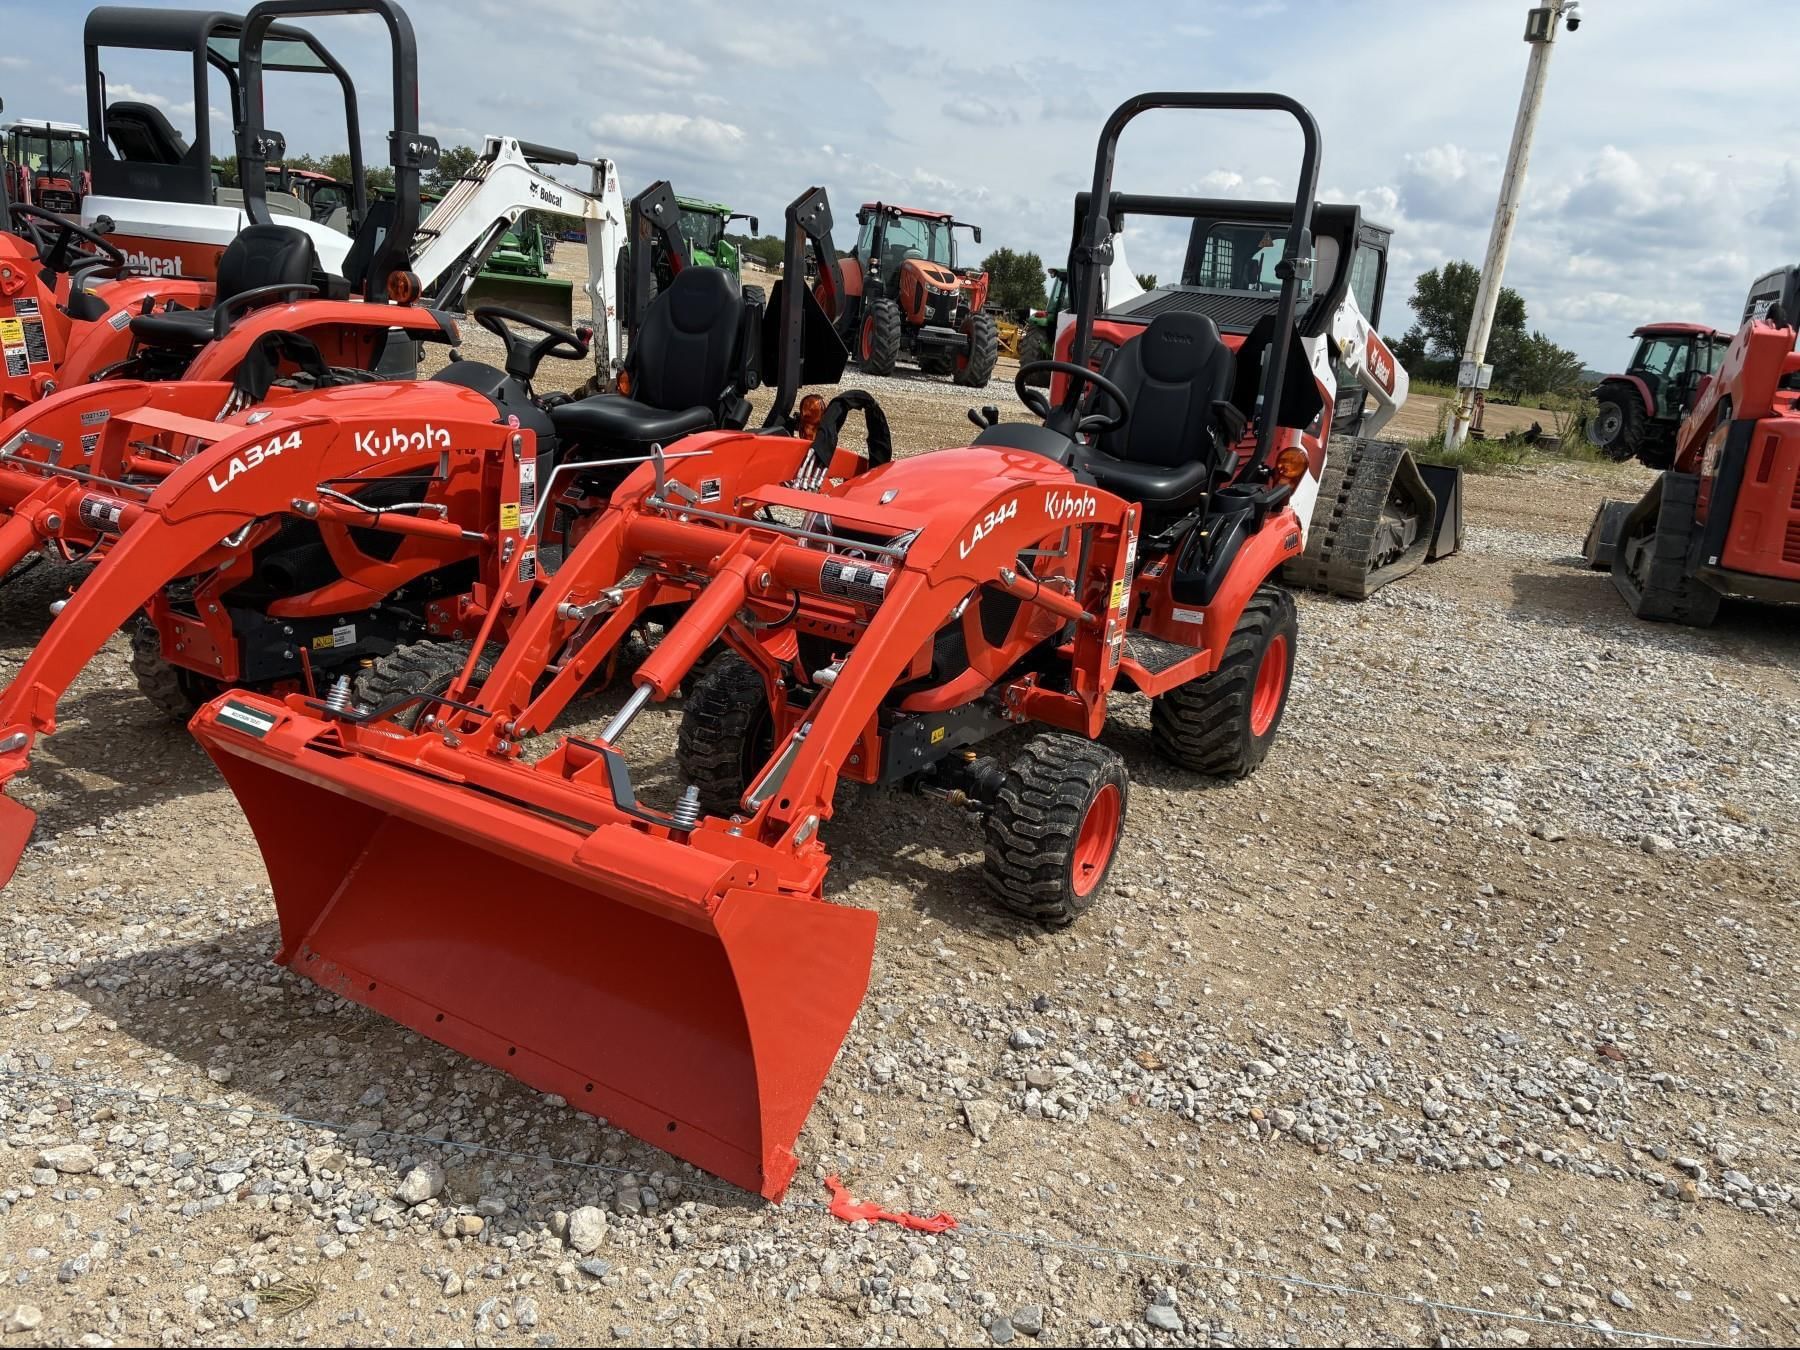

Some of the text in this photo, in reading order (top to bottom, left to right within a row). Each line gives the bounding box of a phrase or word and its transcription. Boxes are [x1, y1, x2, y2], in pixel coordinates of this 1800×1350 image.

[540, 187, 562, 208] Bobcat
[354, 424, 451, 457] Kubota
[207, 430, 302, 493] LA344
[1045, 490, 1096, 520] Kubota
[959, 499, 1018, 560] LA344
